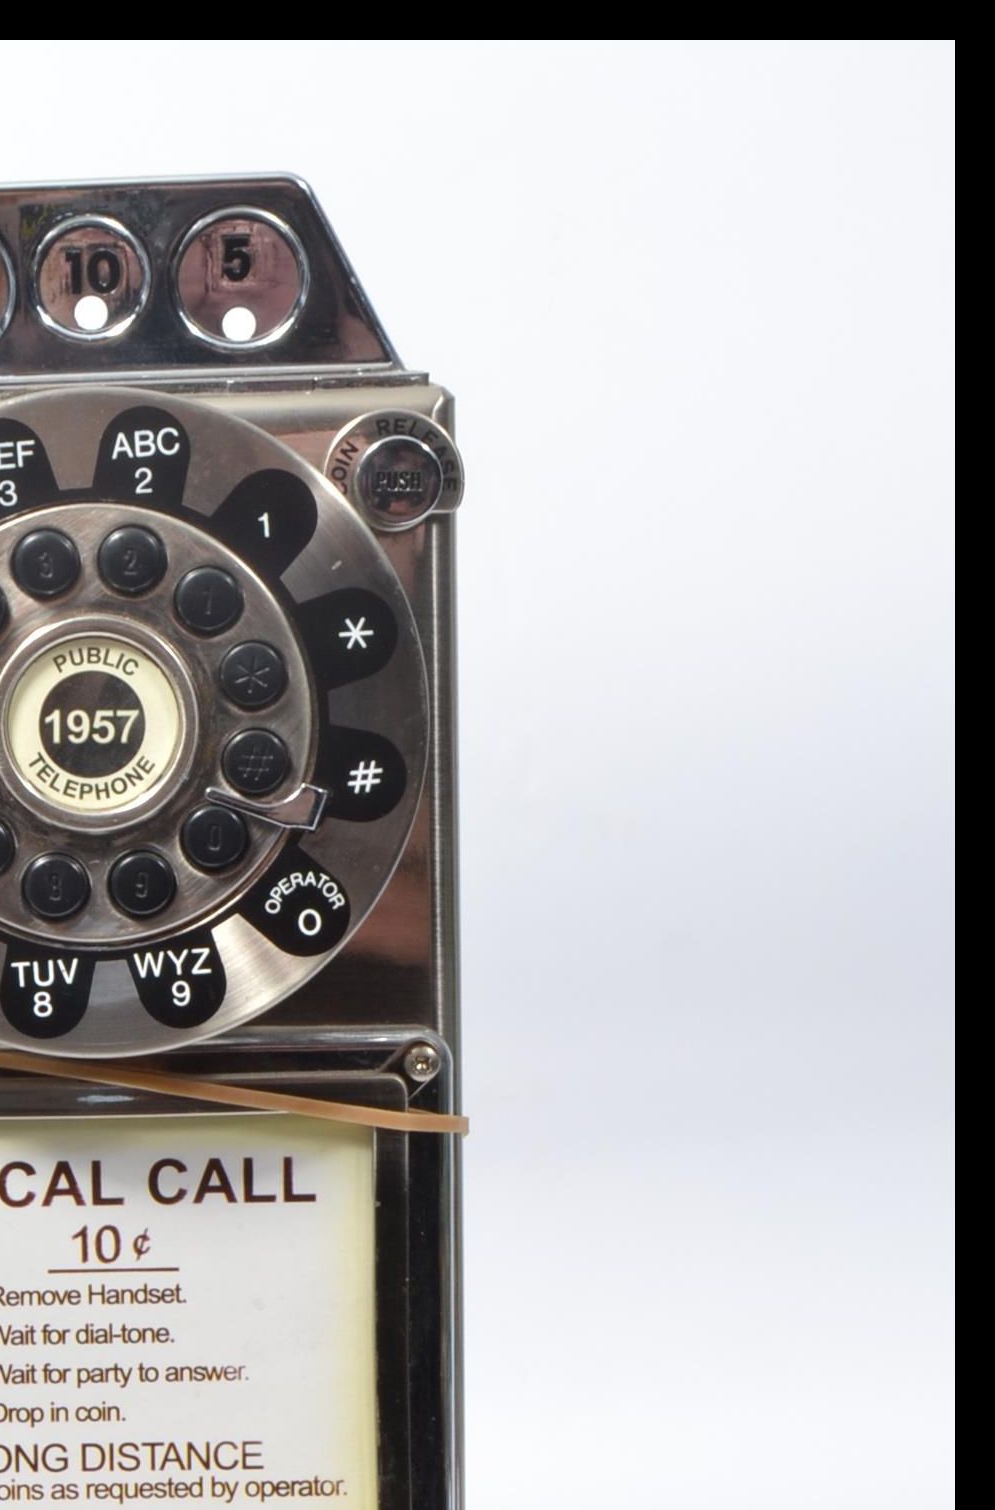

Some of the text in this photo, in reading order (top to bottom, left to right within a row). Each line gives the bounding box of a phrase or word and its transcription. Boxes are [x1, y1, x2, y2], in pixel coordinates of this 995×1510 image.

[63, 246, 121, 295] 10
[221, 233, 251, 281] 5
[111, 427, 181, 459] ABC
[376, 418, 457, 491] RELEASE
[134, 467, 154, 494] 2
[375, 470, 422, 491] PUSH
[257, 512, 270, 538] 1
[52, 647, 139, 676] PUBLIC
[44, 709, 140, 744] 1957
[28, 752, 156, 800] TELEPHONE
[265, 871, 346, 915] OPERATOR
[10, 958, 79, 988] TUV
[133, 948, 212, 979] WYZ
[33, 991, 53, 1018] 8
[171, 980, 192, 1007] 9
[148, 1157, 317, 1205] CALL
[71, 1224, 122, 1264] 10
[88, 1283, 187, 1305] Handset.
[41, 1323, 71, 1344] for
[75, 1323, 175, 1344] dial-tone.
[42, 1363, 71, 1384] for
[77, 1363, 132, 1389] party
[138, 1363, 160, 1383] to
[165, 1365, 250, 1383] answer.
[50, 1401, 69, 1422] in
[75, 1401, 126, 1422] coin.
[81, 1440, 265, 1473] DISTANCE
[51, 1482, 79, 1500] as
[86, 1476, 204, 1505] requested
[211, 1476, 239, 1503] by
[245, 1476, 348, 1502] operator.
